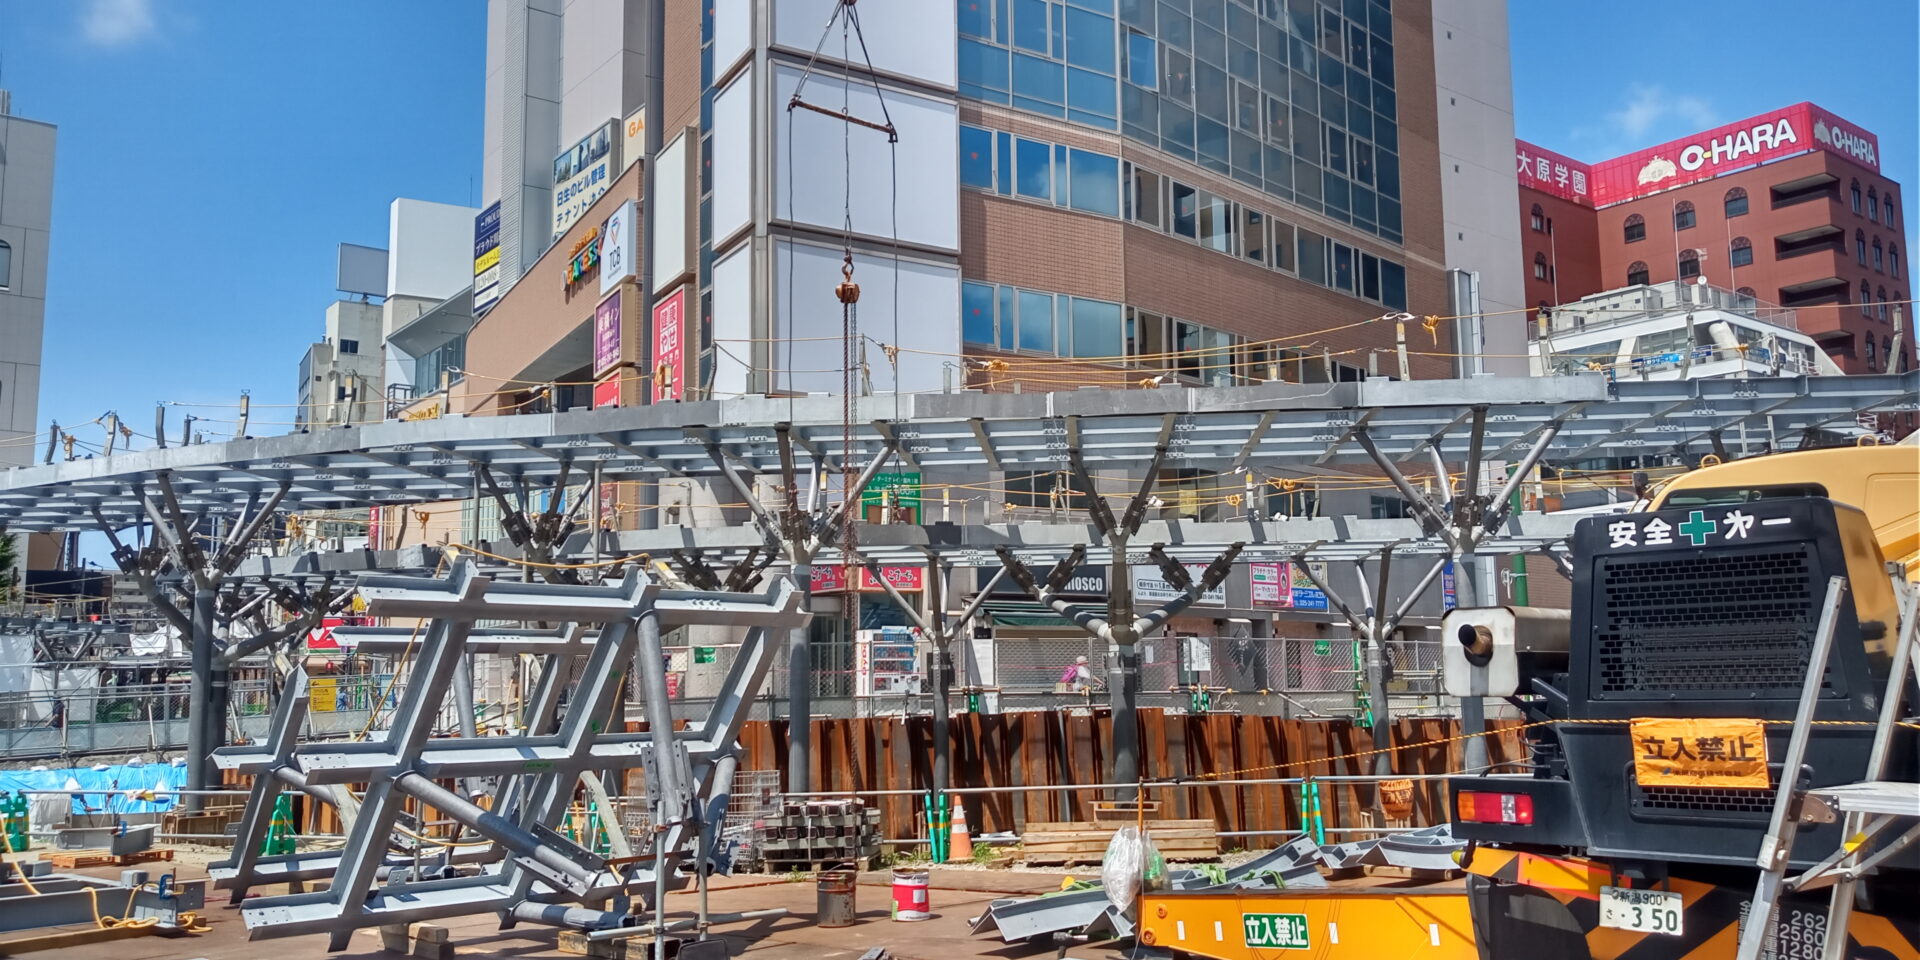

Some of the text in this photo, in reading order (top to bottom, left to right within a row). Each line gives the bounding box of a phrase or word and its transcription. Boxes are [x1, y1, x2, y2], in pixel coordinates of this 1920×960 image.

[557, 163, 606, 207] 日生のビル管理
[1517, 151, 1587, 195] 大原学園
[1608, 519, 1673, 548] 安全
[1641, 736, 1757, 762] 立入禁止
[1245, 917, 1308, 945] 立入禁止
